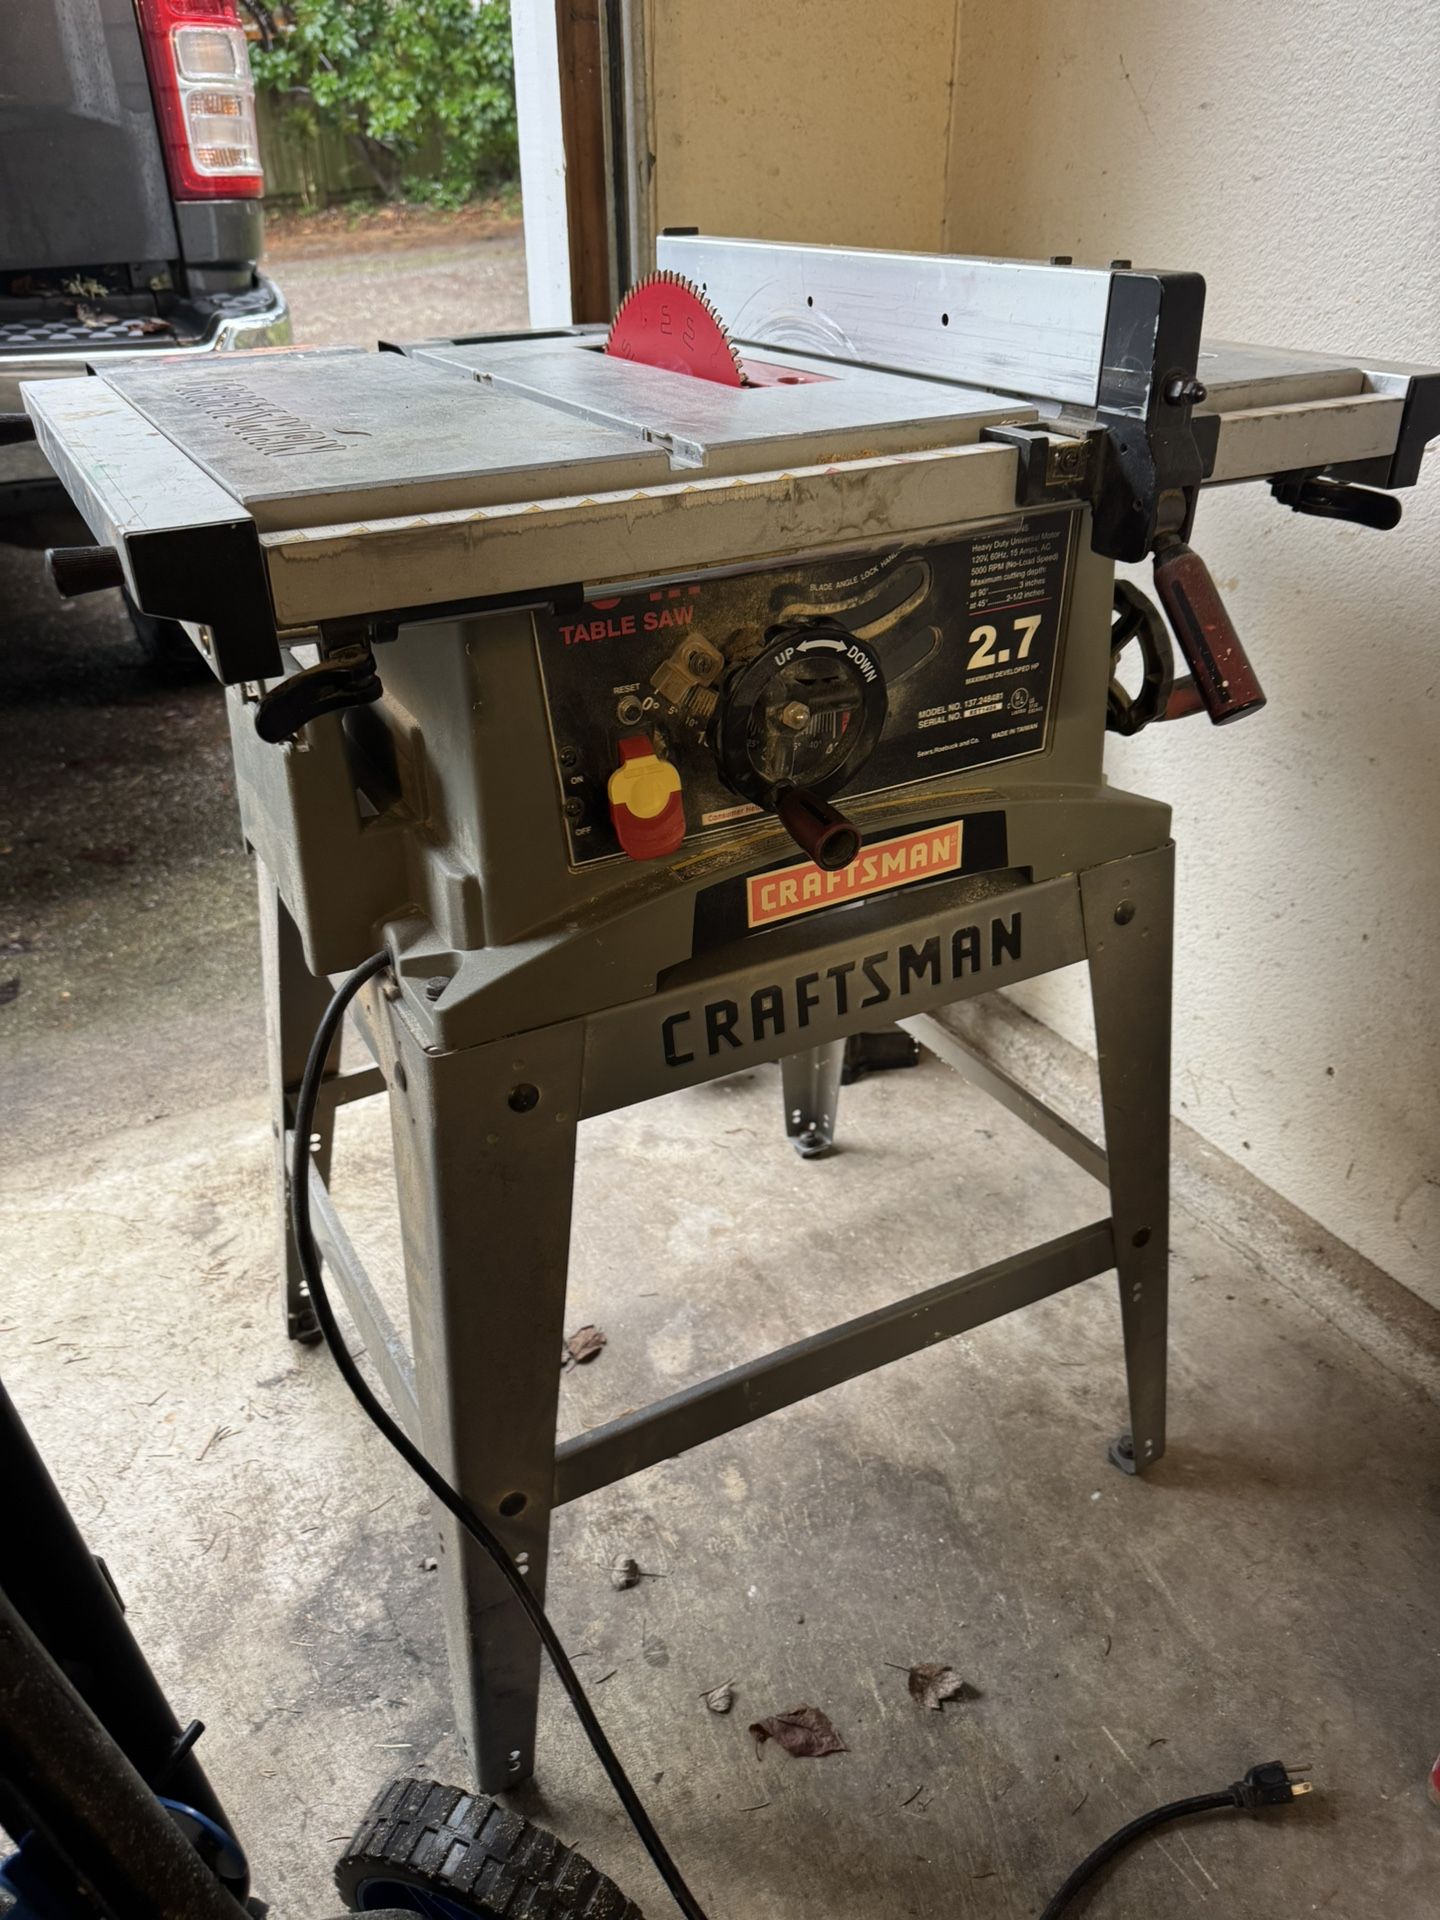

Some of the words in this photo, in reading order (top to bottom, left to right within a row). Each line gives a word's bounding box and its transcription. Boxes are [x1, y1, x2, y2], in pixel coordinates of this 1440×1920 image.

[971, 542, 992, 553] Heavy
[993, 540, 1009, 549] Duty
[1041, 530, 1061, 540] Motor
[1009, 548, 1018, 556] 15
[1040, 542, 1051, 551] AC
[971, 566, 987, 576] 5000
[988, 563, 1005, 573] RPM
[1005, 557, 1035, 570] (No-Load
[1036, 552, 1059, 564] Speed)
[809, 583, 833, 592] BLADE
[836, 575, 859, 589] ANGLE
[860, 564, 879, 580] LOCK
[970, 574, 1002, 587] Maximum
[1003, 570, 1026, 582] cutting
[969, 591, 977, 599] at
[1024, 578, 1046, 588] inches
[969, 602, 977, 610] at
[1024, 588, 1046, 598] inches
[559, 615, 637, 646] TABLE
[643, 605, 695, 632] SAW
[966, 614, 1042, 671] 2.7
[774, 647, 796, 667] UP
[846, 644, 878, 683] DOWN
[994, 665, 1030, 680] DEVELOPED
[1031, 662, 1040, 671] HP
[613, 682, 641, 694] RESET
[918, 705, 946, 719] MODEL
[948, 702, 962, 711] NO.
[917, 715, 947, 729] SERIAL
[948, 711, 962, 722] NO.
[1016, 723, 1038, 733] TAIWAN
[959, 739, 970, 747] and
[570, 775, 584, 785] ON
[707, 808, 744, 822] Consumer
[575, 825, 592, 836] OFF
[760, 834, 951, 912] CRAFTSMAN
[662, 912, 1022, 1067] CRAFTSMAN
